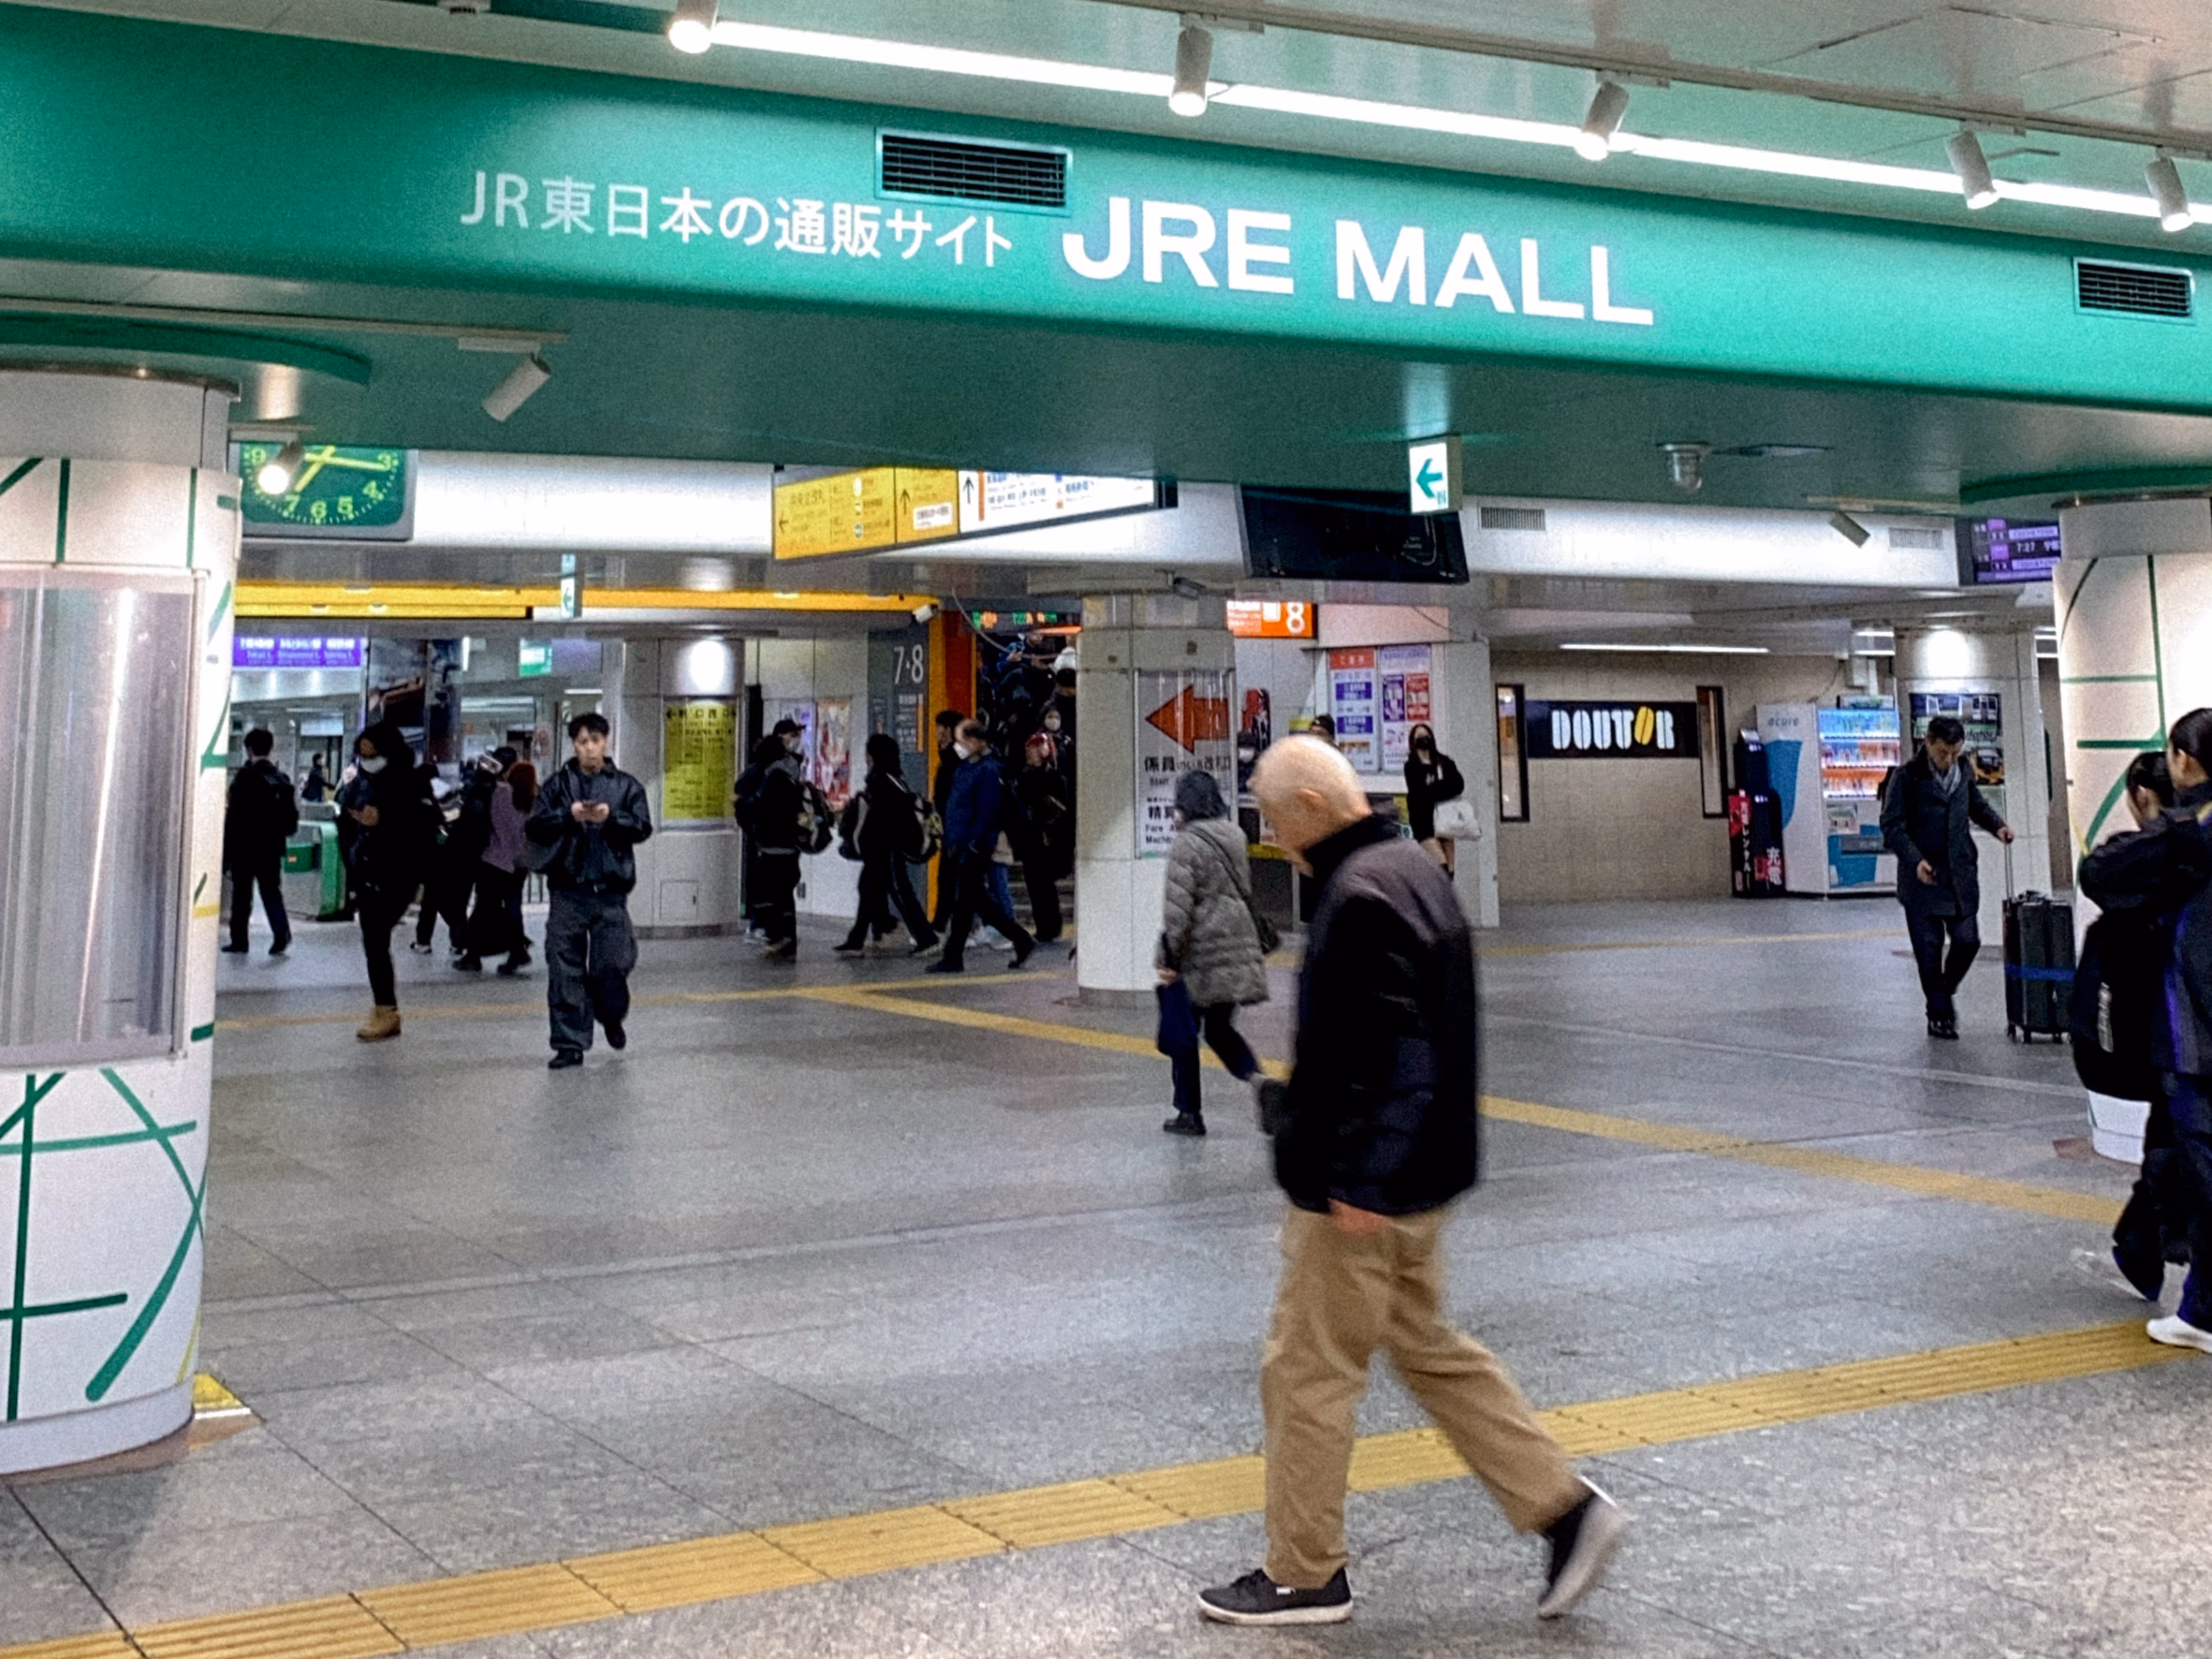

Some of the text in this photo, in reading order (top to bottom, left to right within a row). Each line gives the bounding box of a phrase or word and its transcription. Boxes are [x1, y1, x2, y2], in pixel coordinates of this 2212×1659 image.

[461, 170, 1013, 267] JR東日本の通販サイト
[1062, 196, 1654, 325] JRE MALL
[362, 480, 377, 498] 4
[285, 493, 300, 513] 7
[310, 500, 328, 520] 6
[337, 495, 353, 514] 5
[1285, 601, 1306, 634] 8
[1551, 706, 1676, 750] DOUTOR
